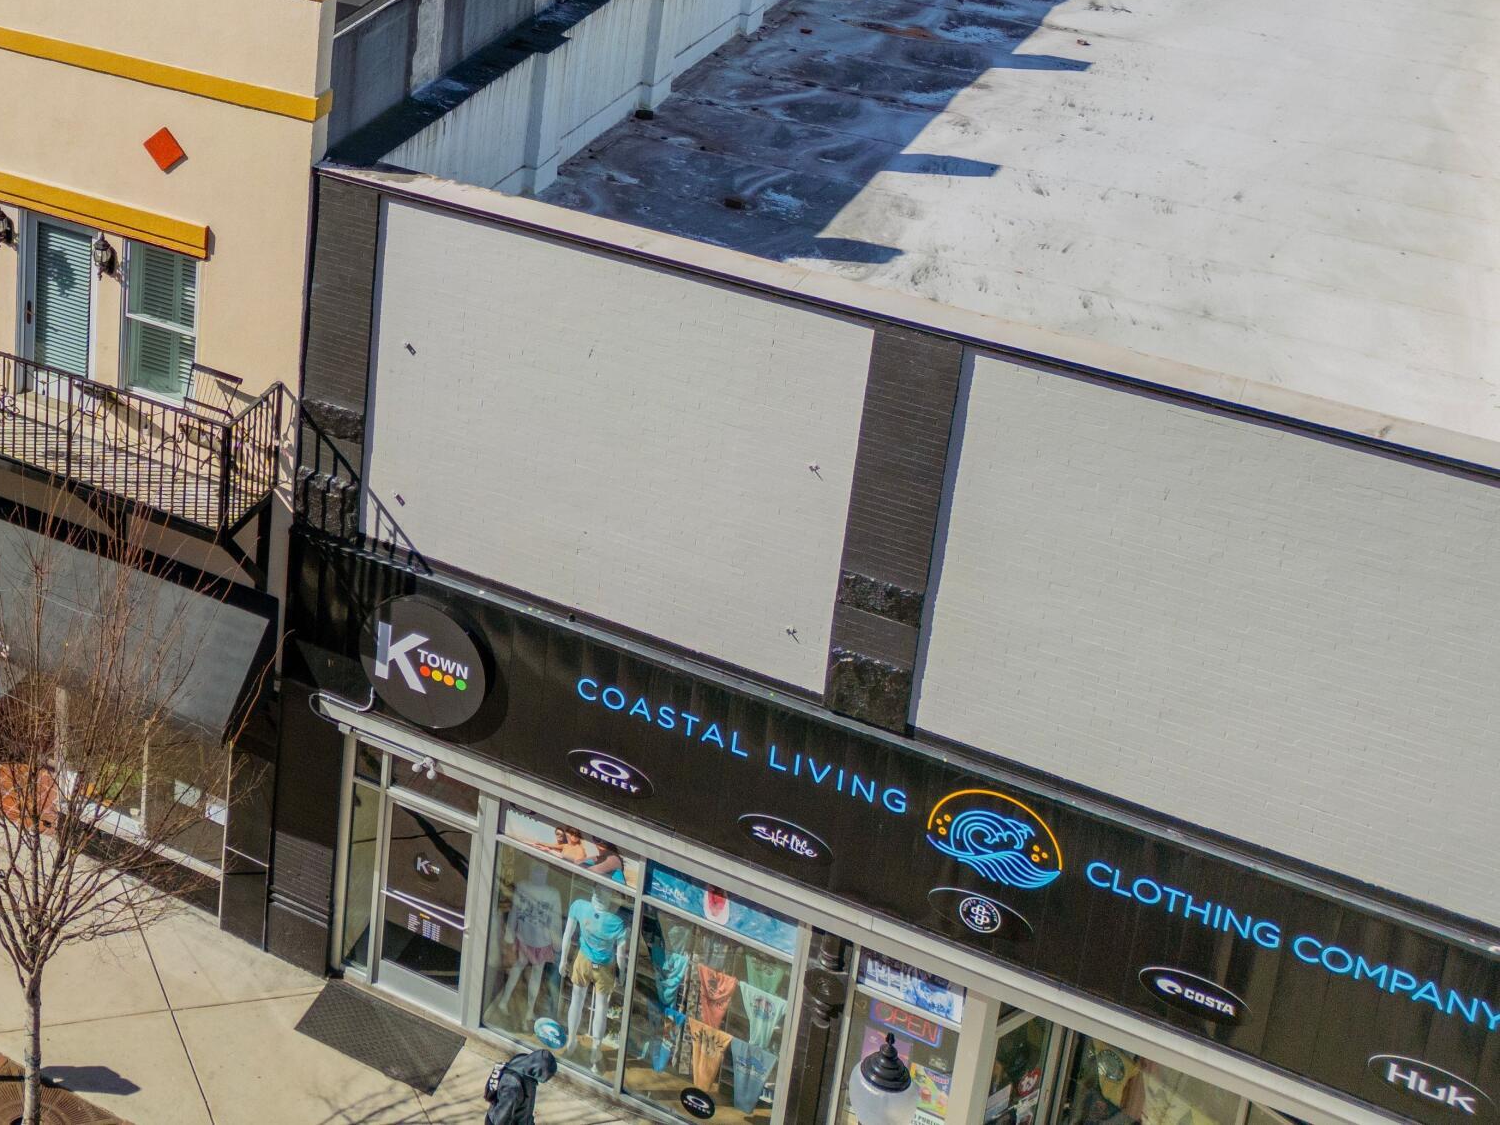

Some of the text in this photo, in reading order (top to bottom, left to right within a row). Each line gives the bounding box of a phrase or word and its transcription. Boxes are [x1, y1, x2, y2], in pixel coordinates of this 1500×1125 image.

[375, 621, 469, 695] K TOWN
[577, 678, 907, 813] COASTAL LIVING
[580, 766, 640, 793] OAKLEY
[1086, 861, 1500, 1031] CLOTHING COMPANY
[875, 1002, 938, 1043] OPEN
[1183, 988, 1235, 1016] COSTA
